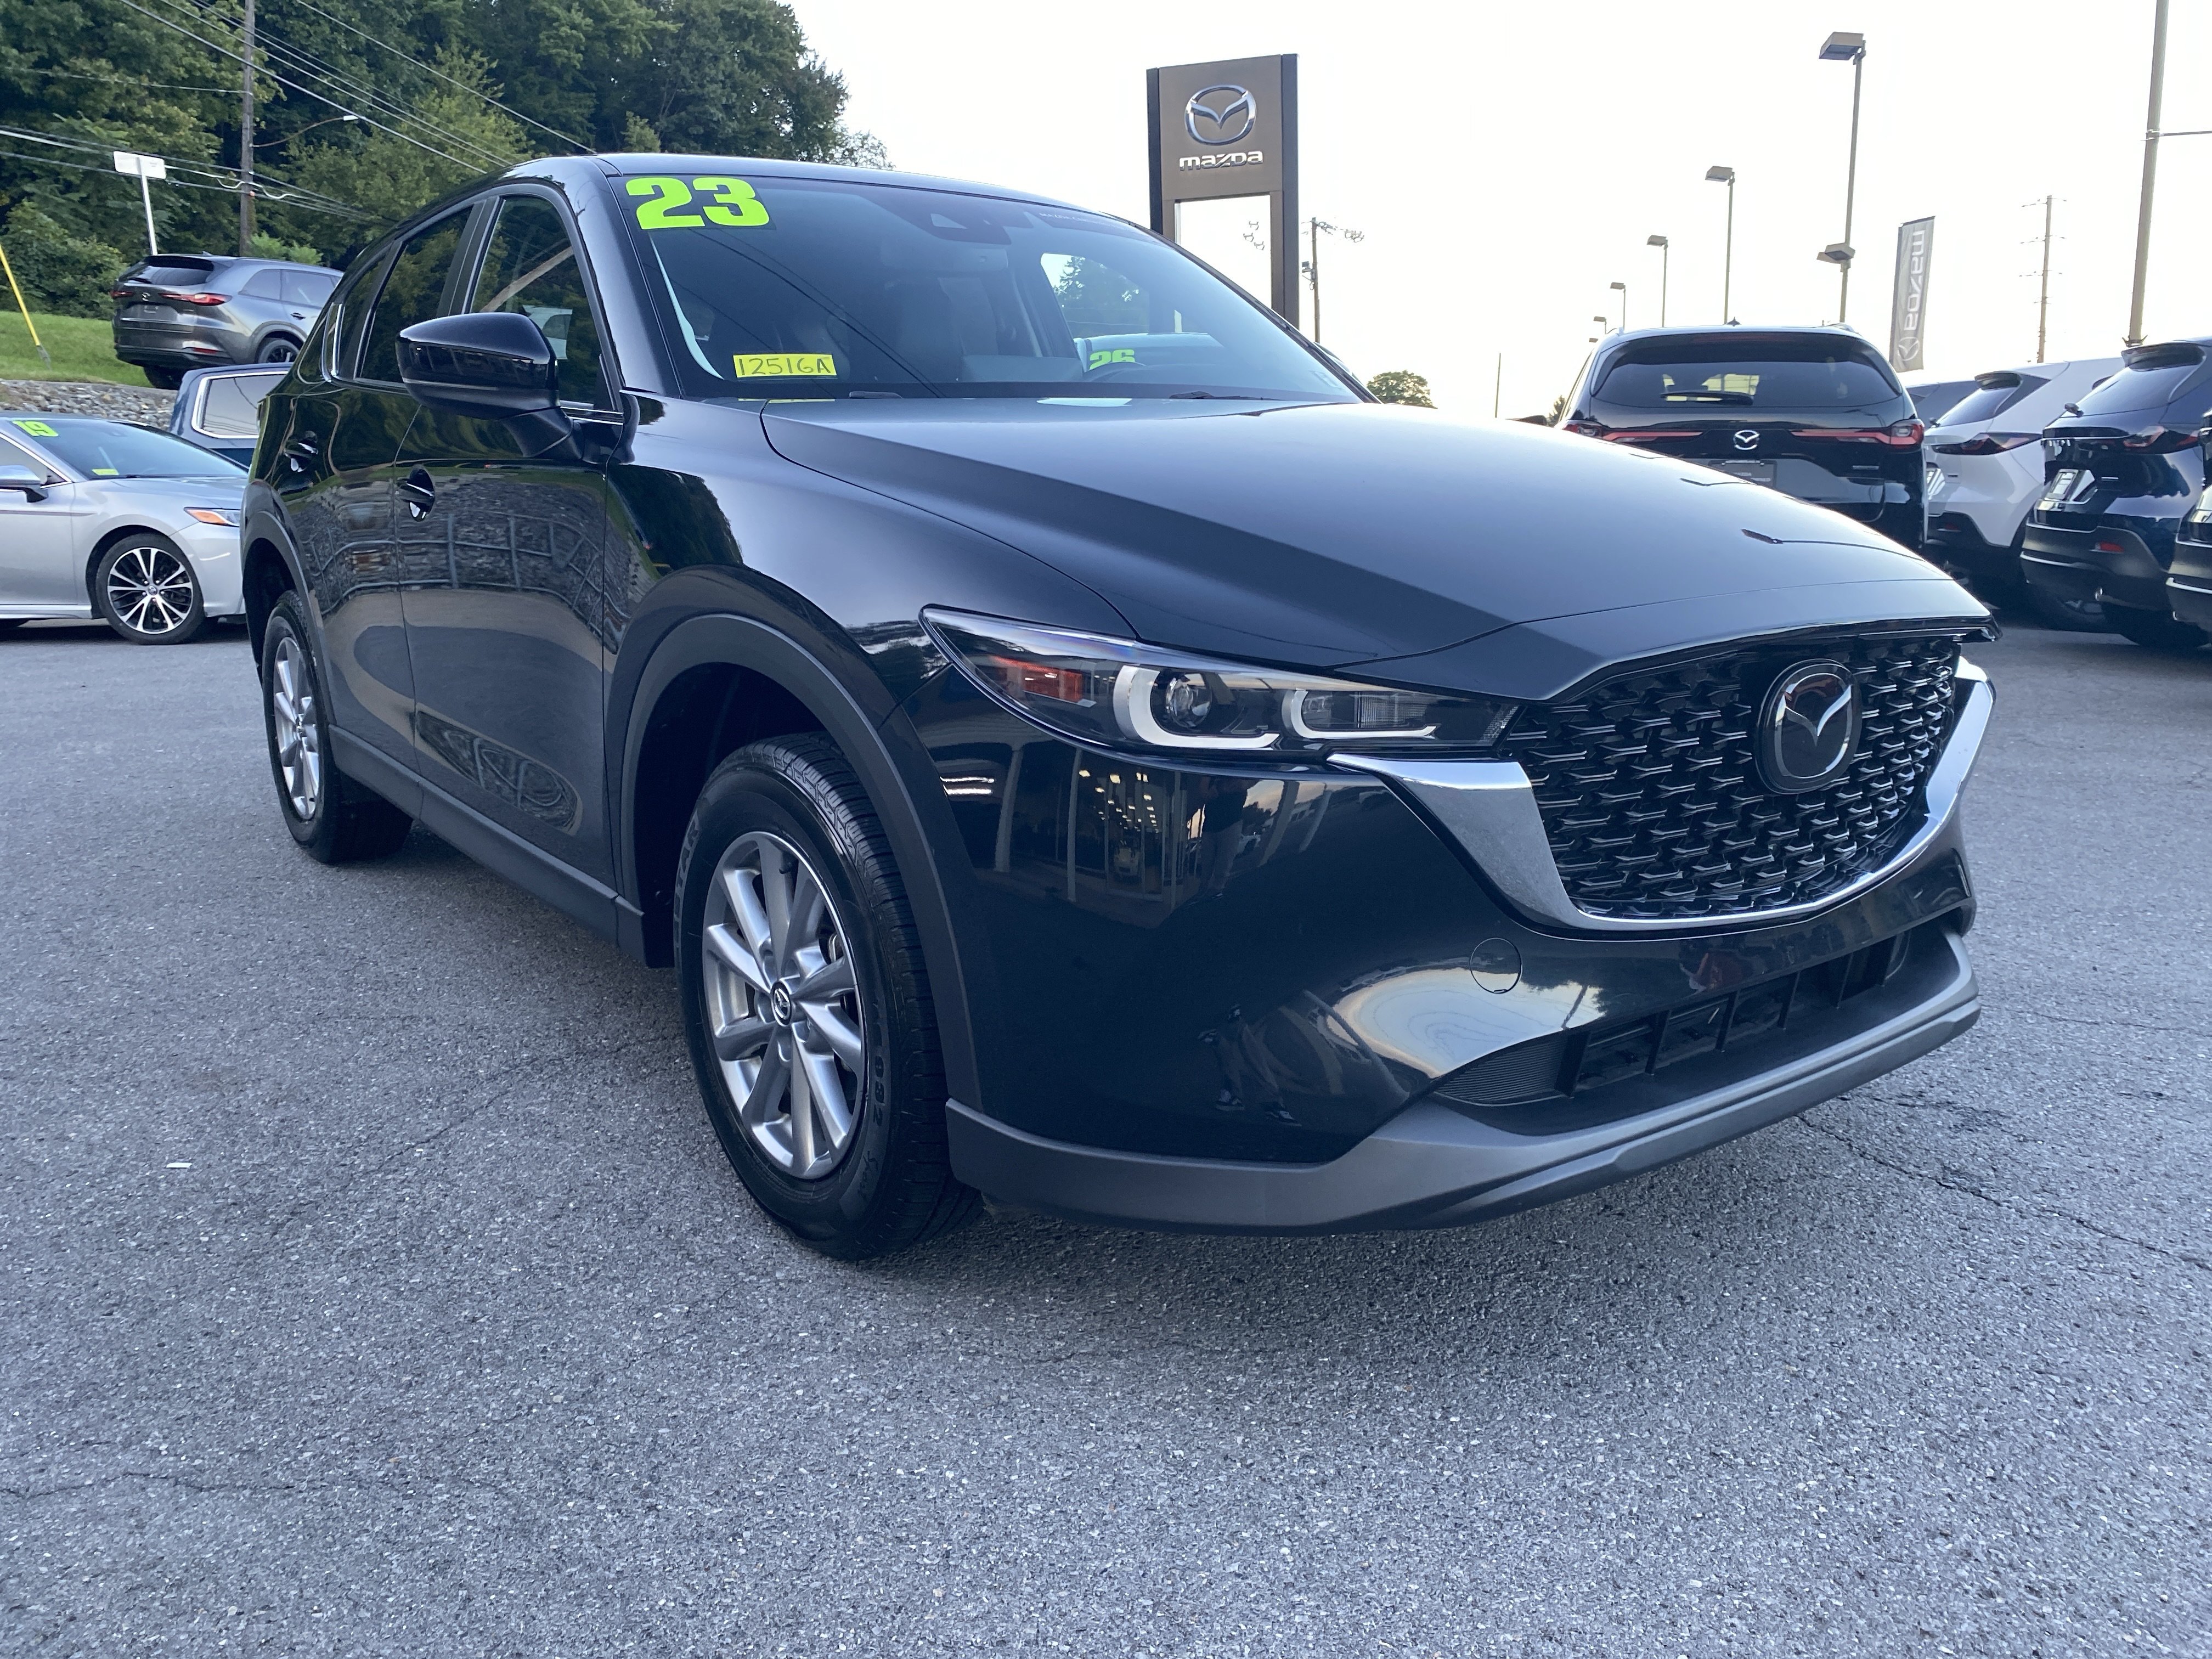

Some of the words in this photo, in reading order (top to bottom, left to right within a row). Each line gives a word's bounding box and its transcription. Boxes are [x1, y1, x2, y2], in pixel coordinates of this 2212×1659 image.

[625, 177, 770, 229] 23
[738, 358, 831, 375] 12516A
[1090, 348, 1136, 370] 26
[12, 421, 59, 437] 19
